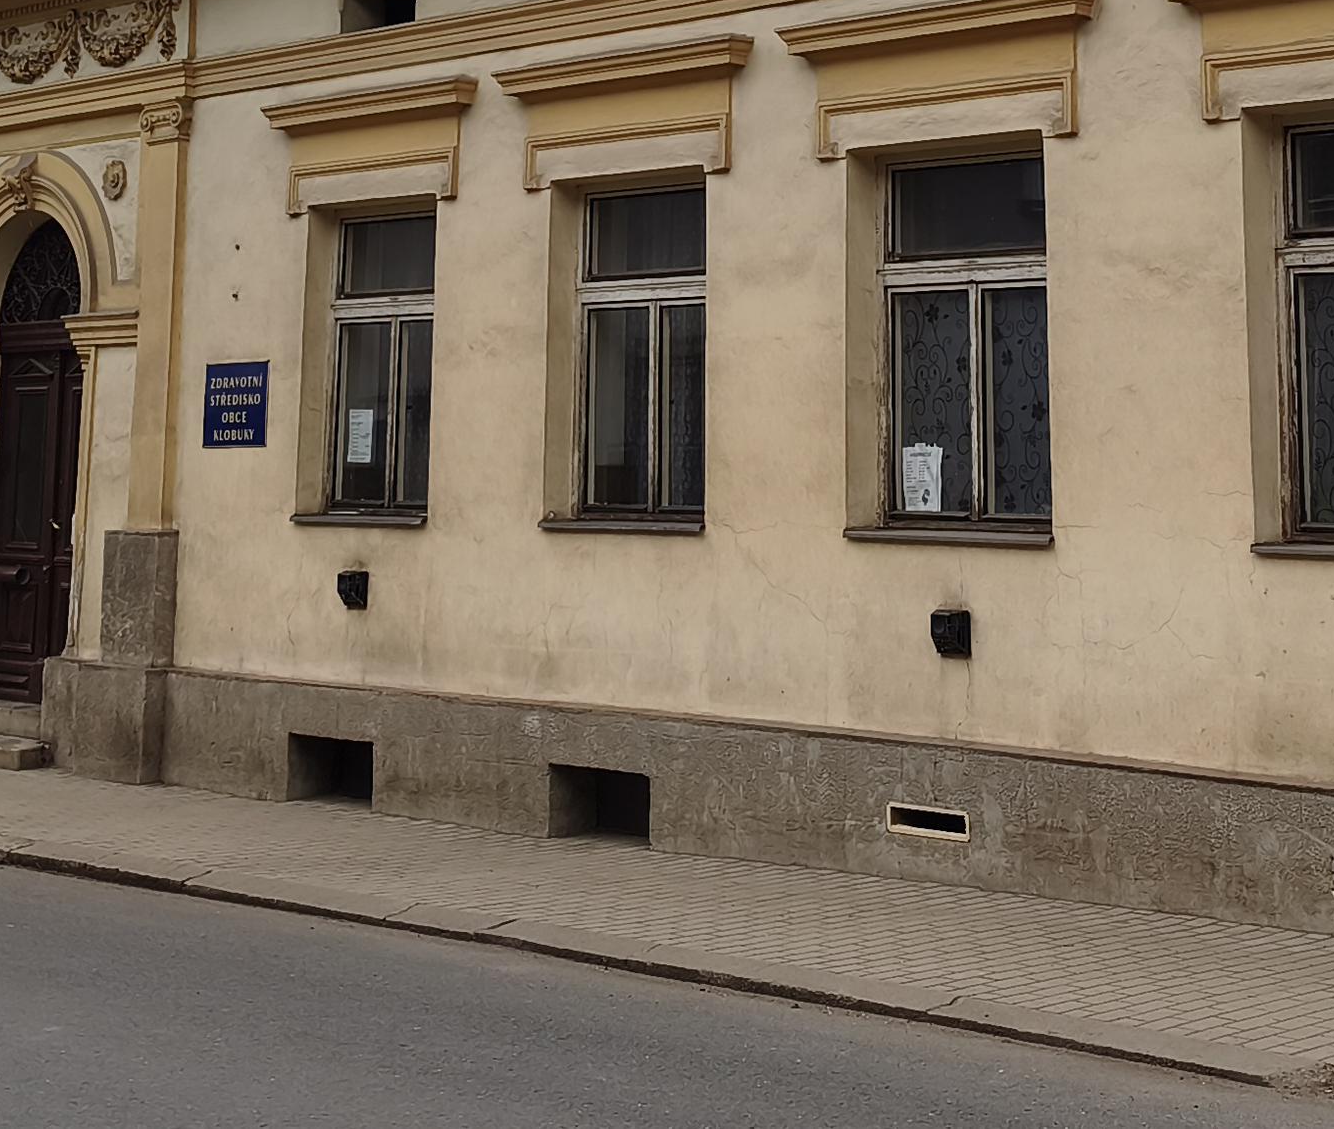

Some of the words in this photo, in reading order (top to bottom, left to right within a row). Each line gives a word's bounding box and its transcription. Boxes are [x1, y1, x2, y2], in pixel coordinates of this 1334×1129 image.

[210, 373, 263, 389] ZDRAVOTNÍ
[210, 392, 261, 406] STŘEDISKO
[221, 411, 247, 423] OBCE
[213, 428, 255, 441] KLOBUKY
